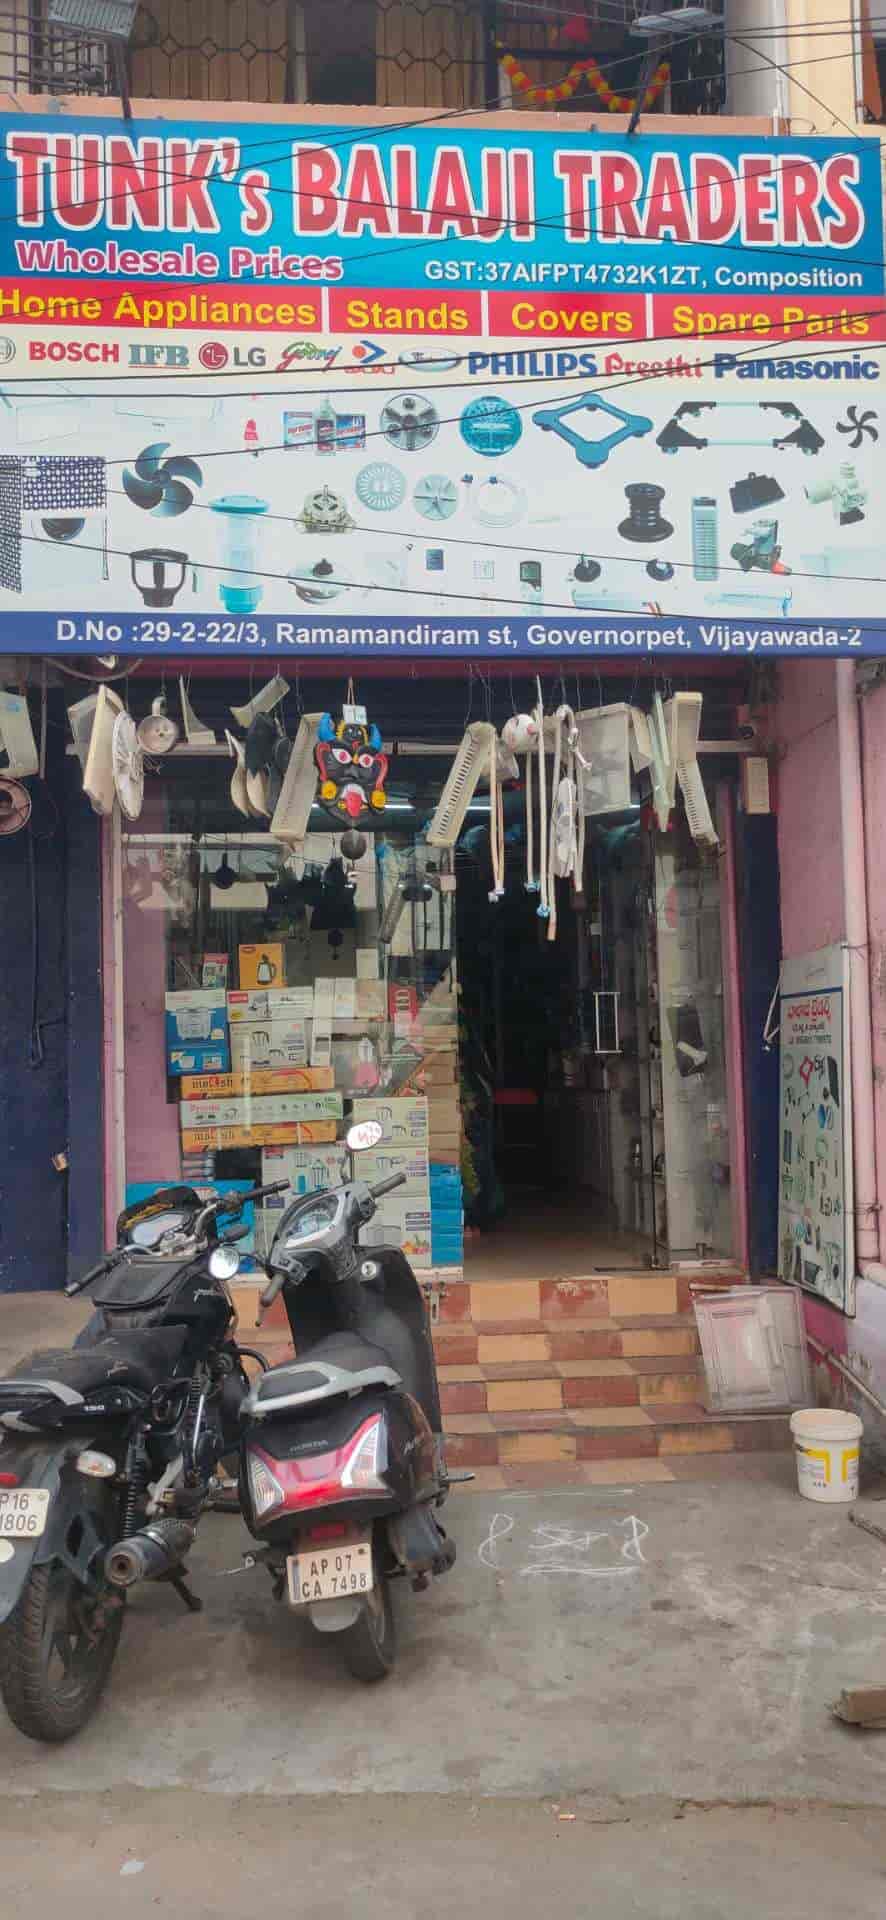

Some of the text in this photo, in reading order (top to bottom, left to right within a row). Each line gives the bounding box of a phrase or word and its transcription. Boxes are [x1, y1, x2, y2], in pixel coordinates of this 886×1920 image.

[7, 131, 865, 249] TUNK's BALAJI TRADERS
[15, 239, 343, 281] Wholesale Prices
[425, 260, 864, 293] GST:37AIFPT4732K1ZT, Composition
[0, 288, 316, 329] Home Appliances
[346, 299, 469, 331] Stands
[511, 302, 634, 333] Covers
[672, 305, 871, 340] Spare Parts
[28, 339, 120, 363] BOSCH
[128, 343, 190, 367] IFB
[233, 346, 266, 368] LG
[467, 350, 598, 378] PHILIPS
[604, 351, 703, 379] Preethi
[713, 353, 880, 380] Panasonic
[56, 619, 863, 653] D.No :29-2-22/3, Ramamandiram st, Governorpet, Vijayawada-2
[310, 1554, 352, 1577] AP 07
[302, 1572, 367, 1599] CA 7498
